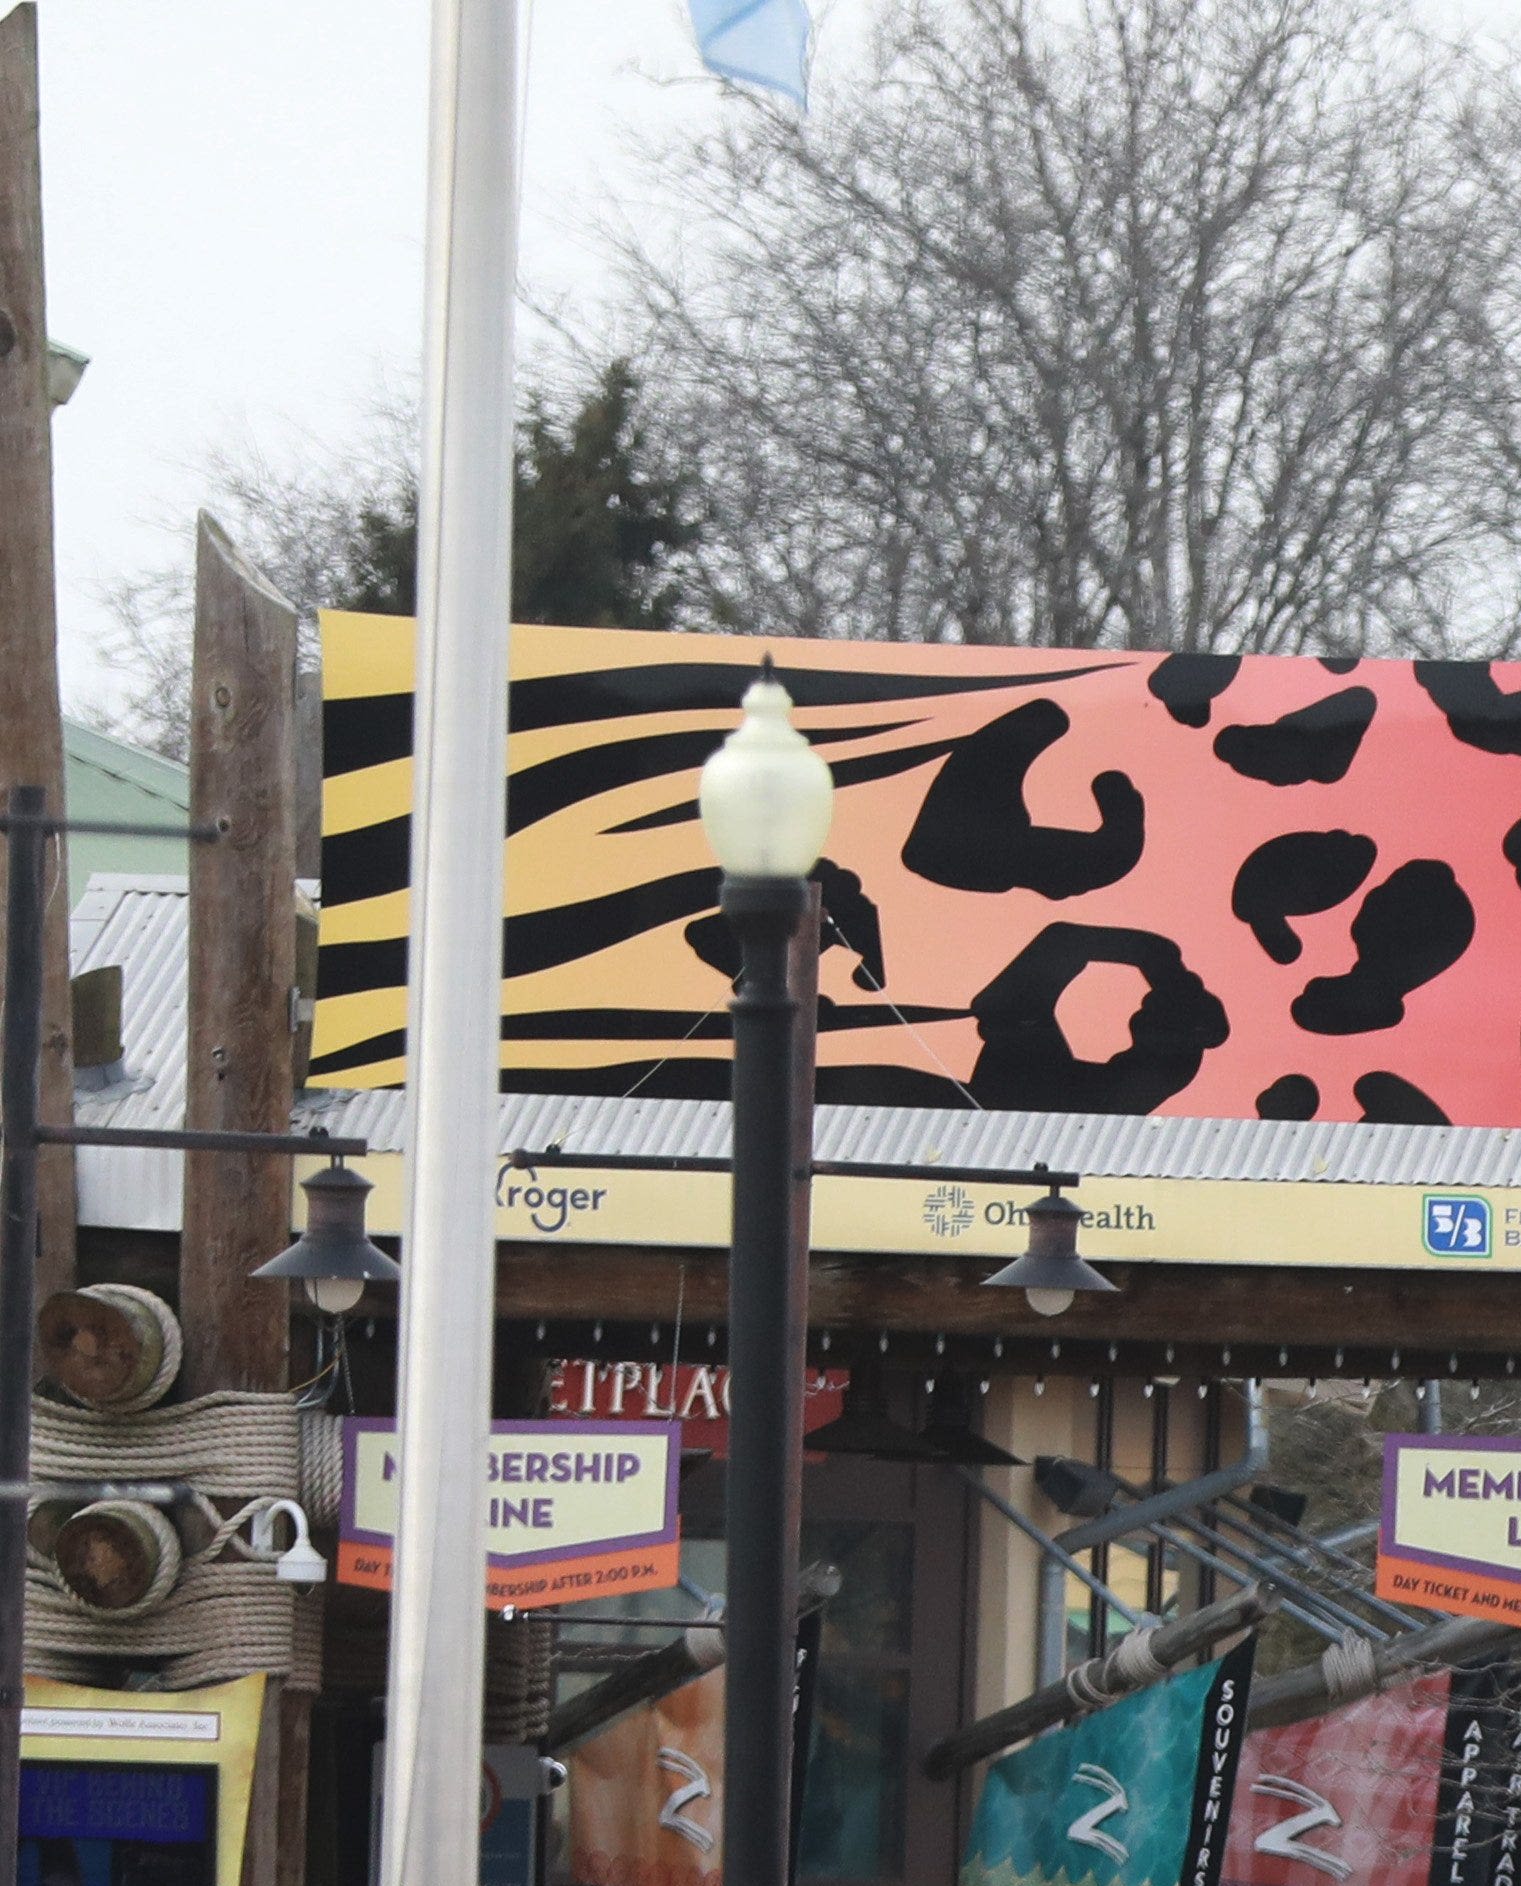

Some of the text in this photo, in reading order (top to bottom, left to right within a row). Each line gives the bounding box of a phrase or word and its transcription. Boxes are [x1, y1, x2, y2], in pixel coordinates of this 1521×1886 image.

[984, 1201, 1156, 1231] Ohealth
[382, 1450, 641, 1484] ERSHIP
[488, 1497, 554, 1529] INE
[550, 1572, 593, 1591] AFTER
[1392, 1573, 1420, 1592] DAY
[1422, 1577, 1470, 1602] TICKET
[1471, 1591, 1500, 1608] AND
[1449, 1718, 1484, 1884] APPAREL
